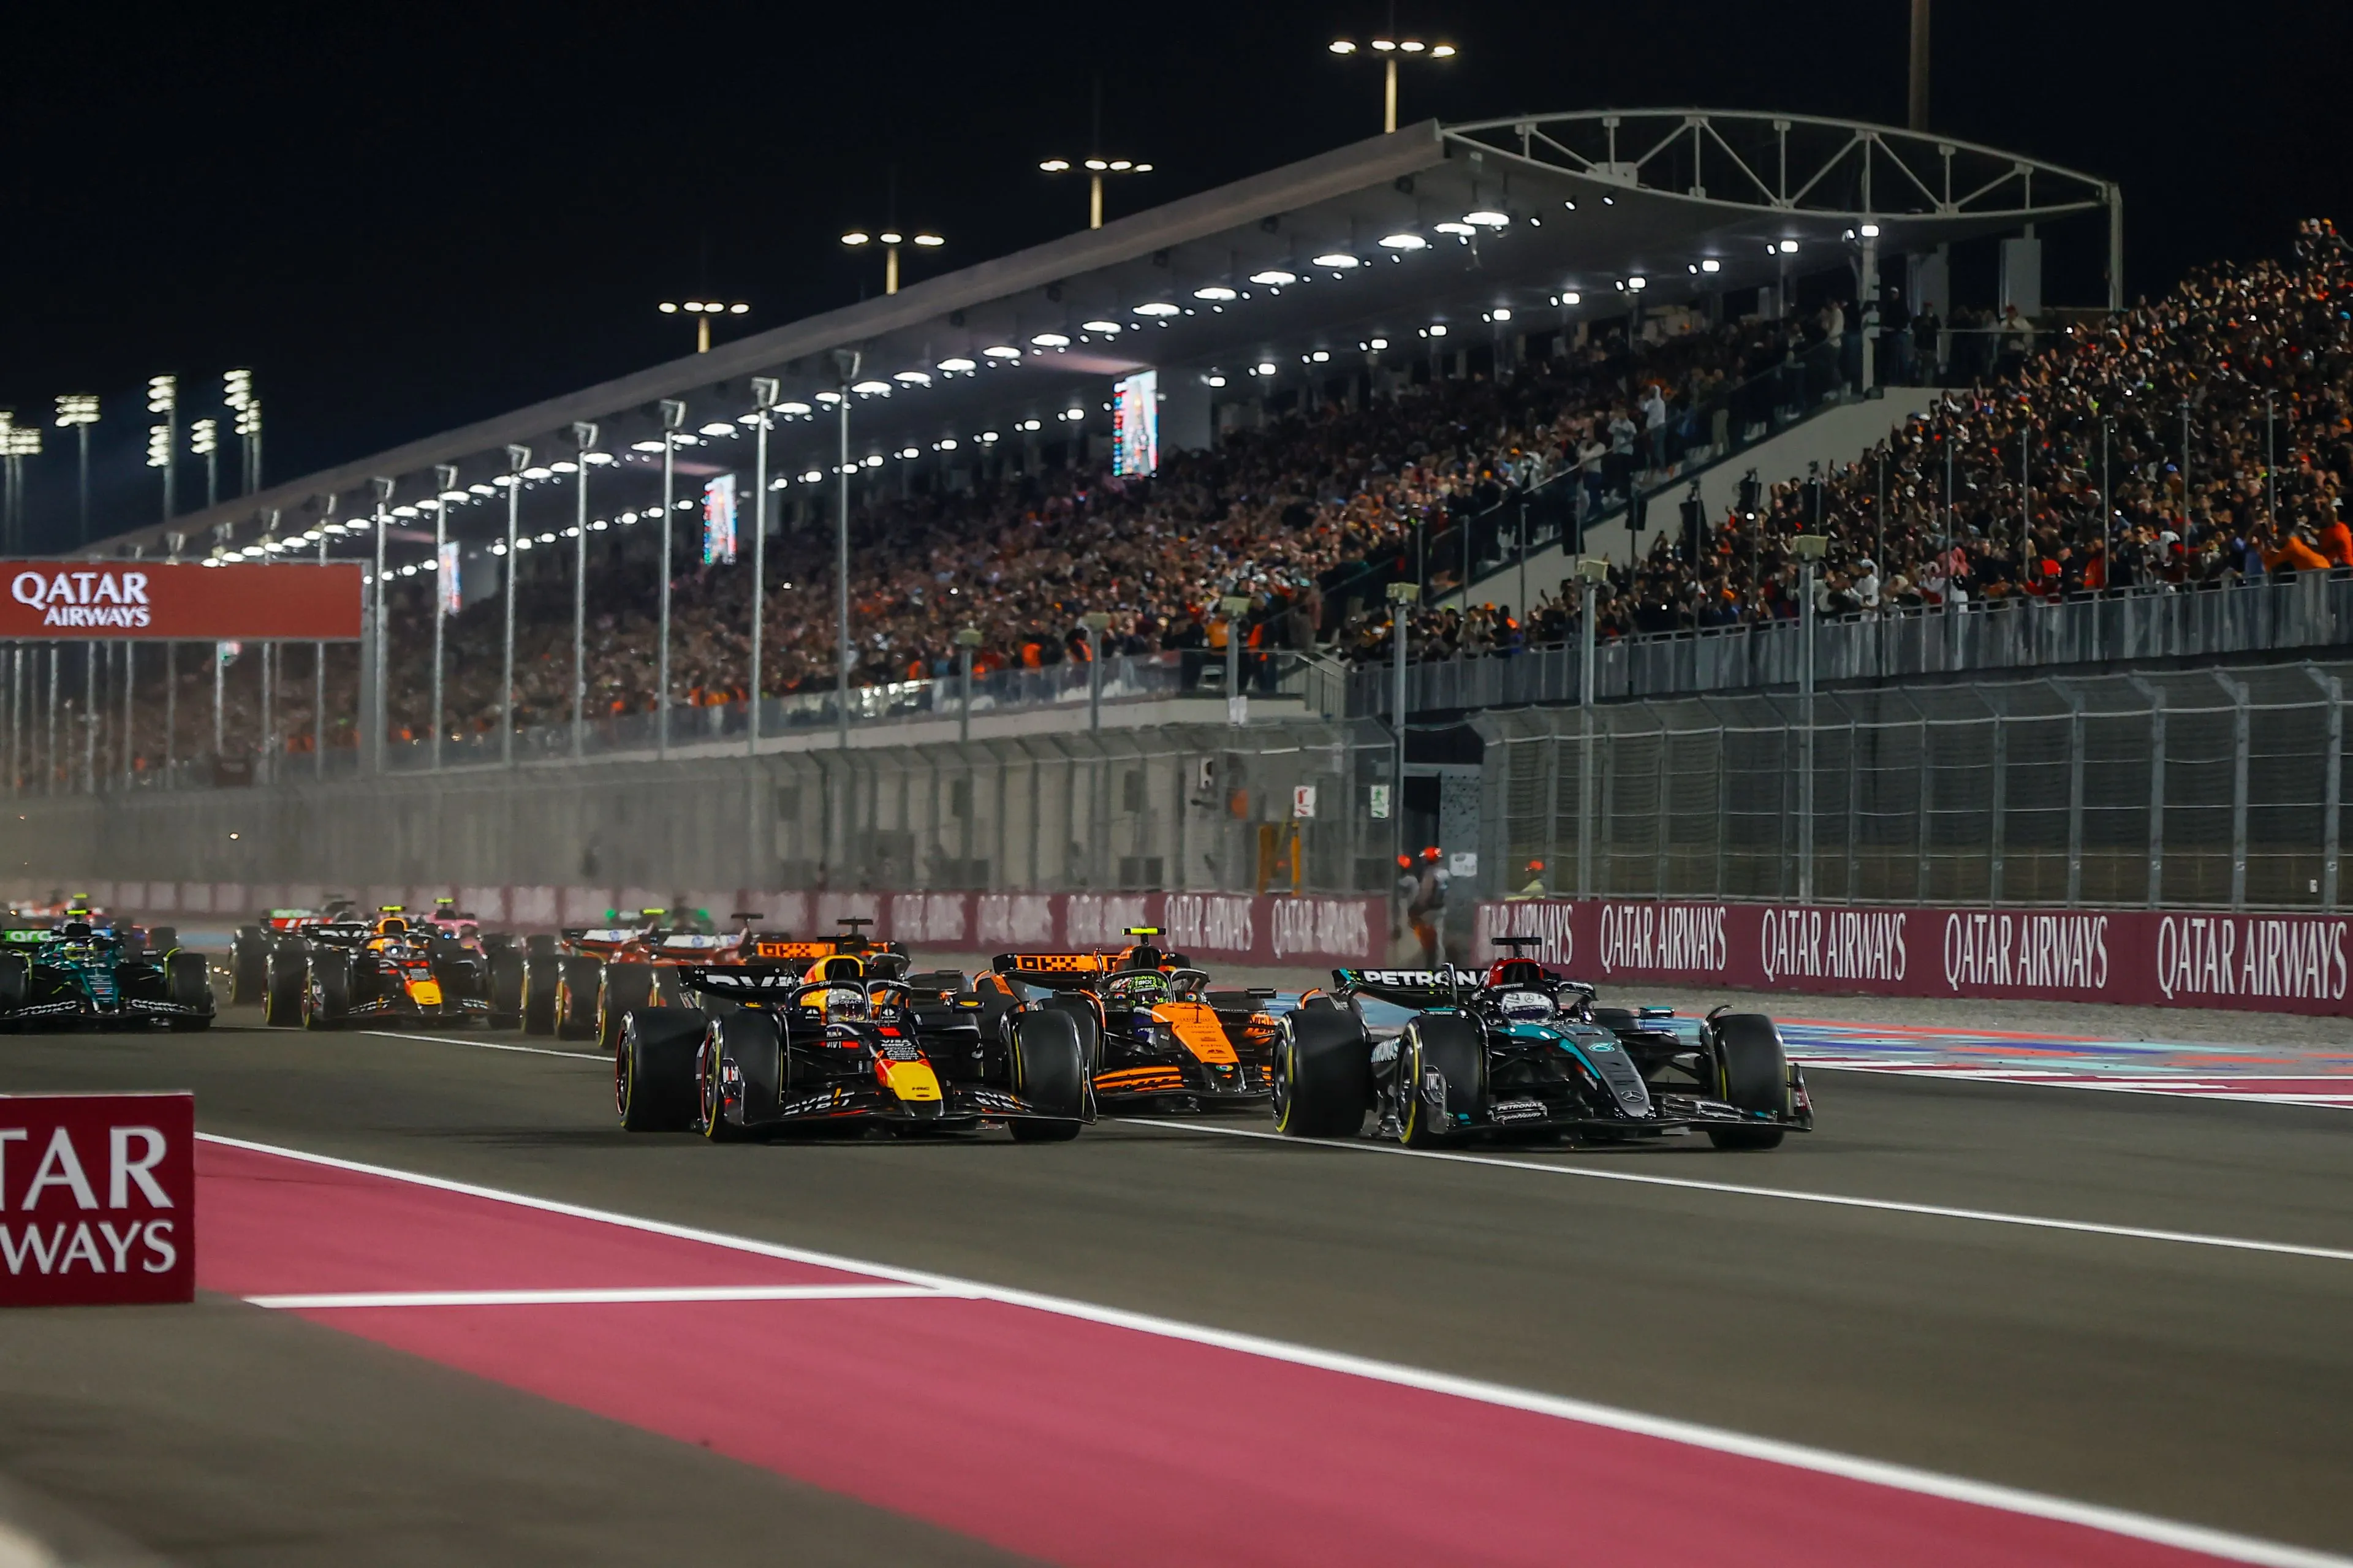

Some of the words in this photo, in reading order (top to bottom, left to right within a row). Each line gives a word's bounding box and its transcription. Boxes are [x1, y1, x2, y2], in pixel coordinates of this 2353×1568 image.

[11, 571, 150, 610] QATAR
[44, 605, 151, 627] AIRWAYS
[1601, 904, 1653, 973] QATAR
[1655, 906, 1726, 971] AIRWAYS
[1762, 909, 1821, 982] QATAR
[1825, 911, 1906, 981] AIRWAYS
[1944, 913, 2012, 991] QATAR
[2017, 915, 2107, 989] AIRWAYS
[2158, 916, 2235, 1000] QATAR
[2240, 919, 2347, 1000] AIRWAYS
[1020, 956, 1077, 971] OKX
[1426, 1074, 1439, 1091] IWC
[1498, 1102, 1543, 1111] PETRONAS
